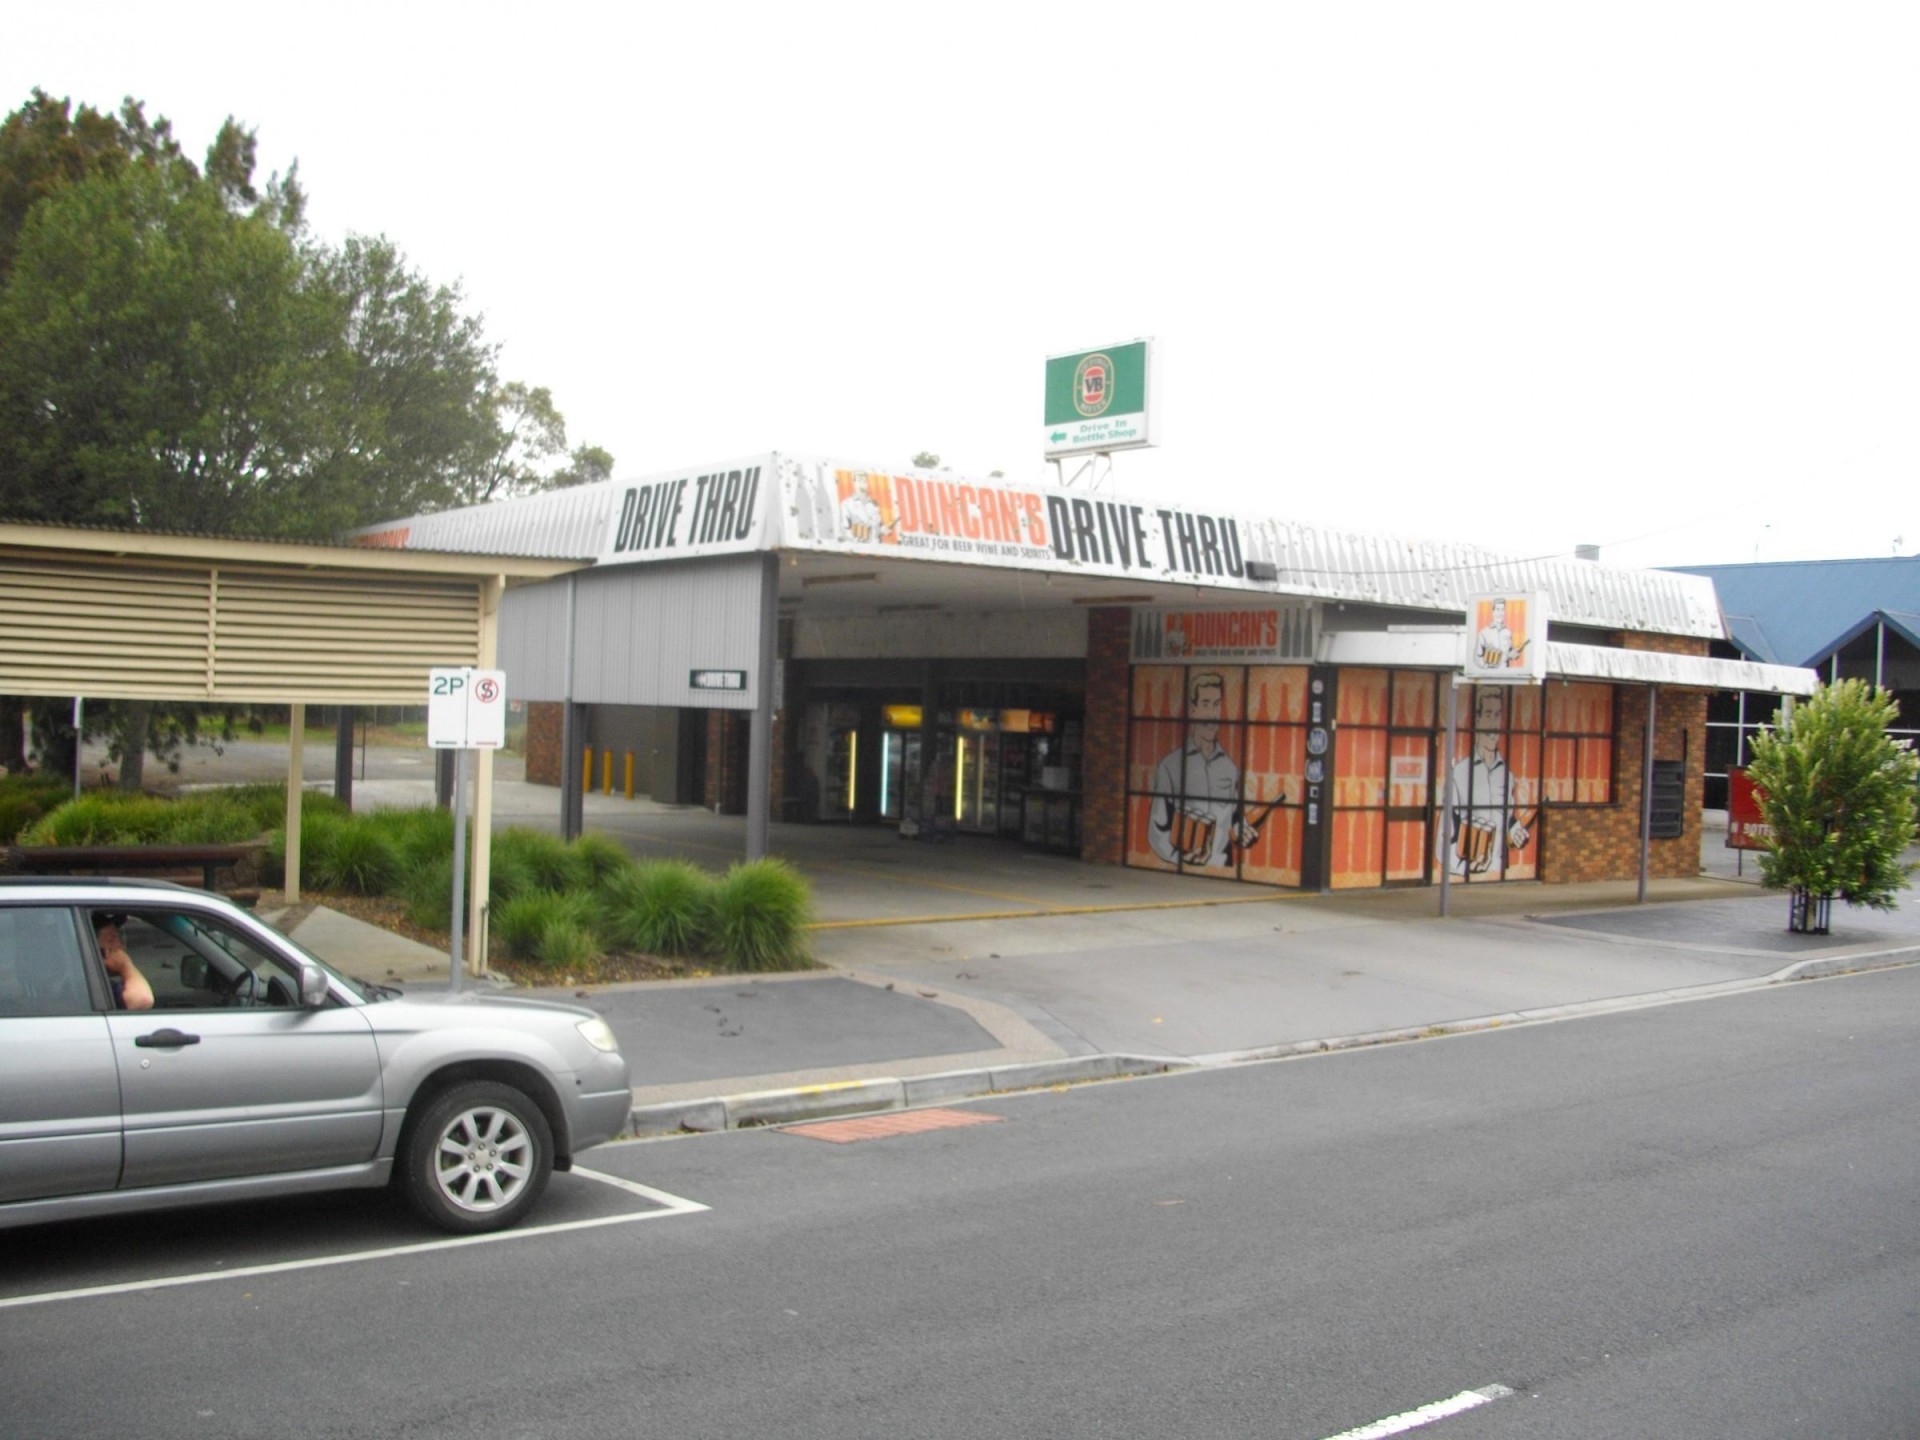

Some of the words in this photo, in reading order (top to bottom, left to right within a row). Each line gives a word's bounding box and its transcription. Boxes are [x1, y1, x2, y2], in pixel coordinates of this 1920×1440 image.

[1085, 377, 1104, 394] VB
[1072, 432, 1106, 444] Bottle
[1108, 428, 1137, 439] Shop
[1080, 422, 1110, 433] Drive
[1115, 419, 1127, 428] In
[614, 478, 688, 553] DRIVE
[688, 466, 762, 546] THRU
[895, 476, 1047, 546] DUNCAN'S
[903, 535, 930, 549] GREAT
[931, 538, 949, 550] FOR
[952, 541, 973, 551] BEER
[1001, 546, 1019, 557] AND
[1047, 494, 1152, 568] DRIVE
[1157, 508, 1246, 578] THRU
[1194, 609, 1277, 648] DUNCAN'S
[433, 676, 464, 695] 2P
